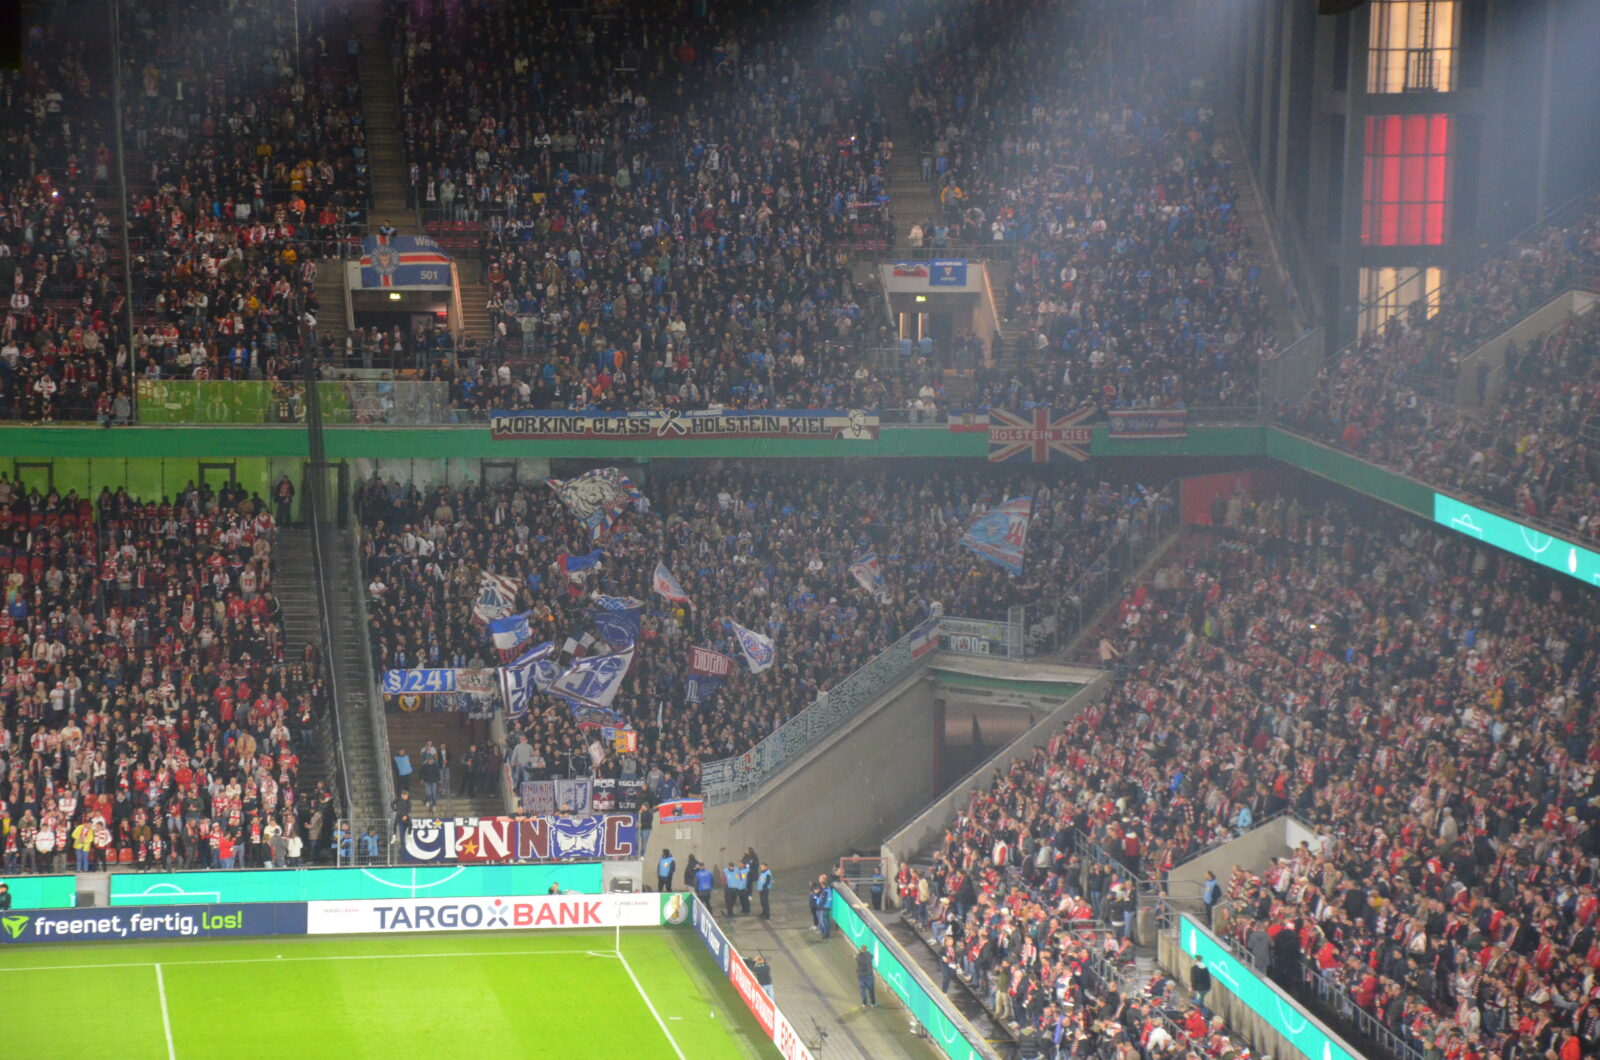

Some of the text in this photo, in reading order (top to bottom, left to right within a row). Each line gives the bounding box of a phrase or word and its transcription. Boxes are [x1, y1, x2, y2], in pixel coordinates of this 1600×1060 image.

[420, 270, 438, 280] 501
[495, 415, 651, 435] WORKING CLASS
[690, 415, 832, 435] HOLSTEIN KIEL
[991, 428, 1089, 440] HOLSTEIN KIEL
[408, 670, 454, 692] 241
[34, 910, 243, 937] freenet, fertig, los!
[373, 901, 602, 929] TARGO BANK
